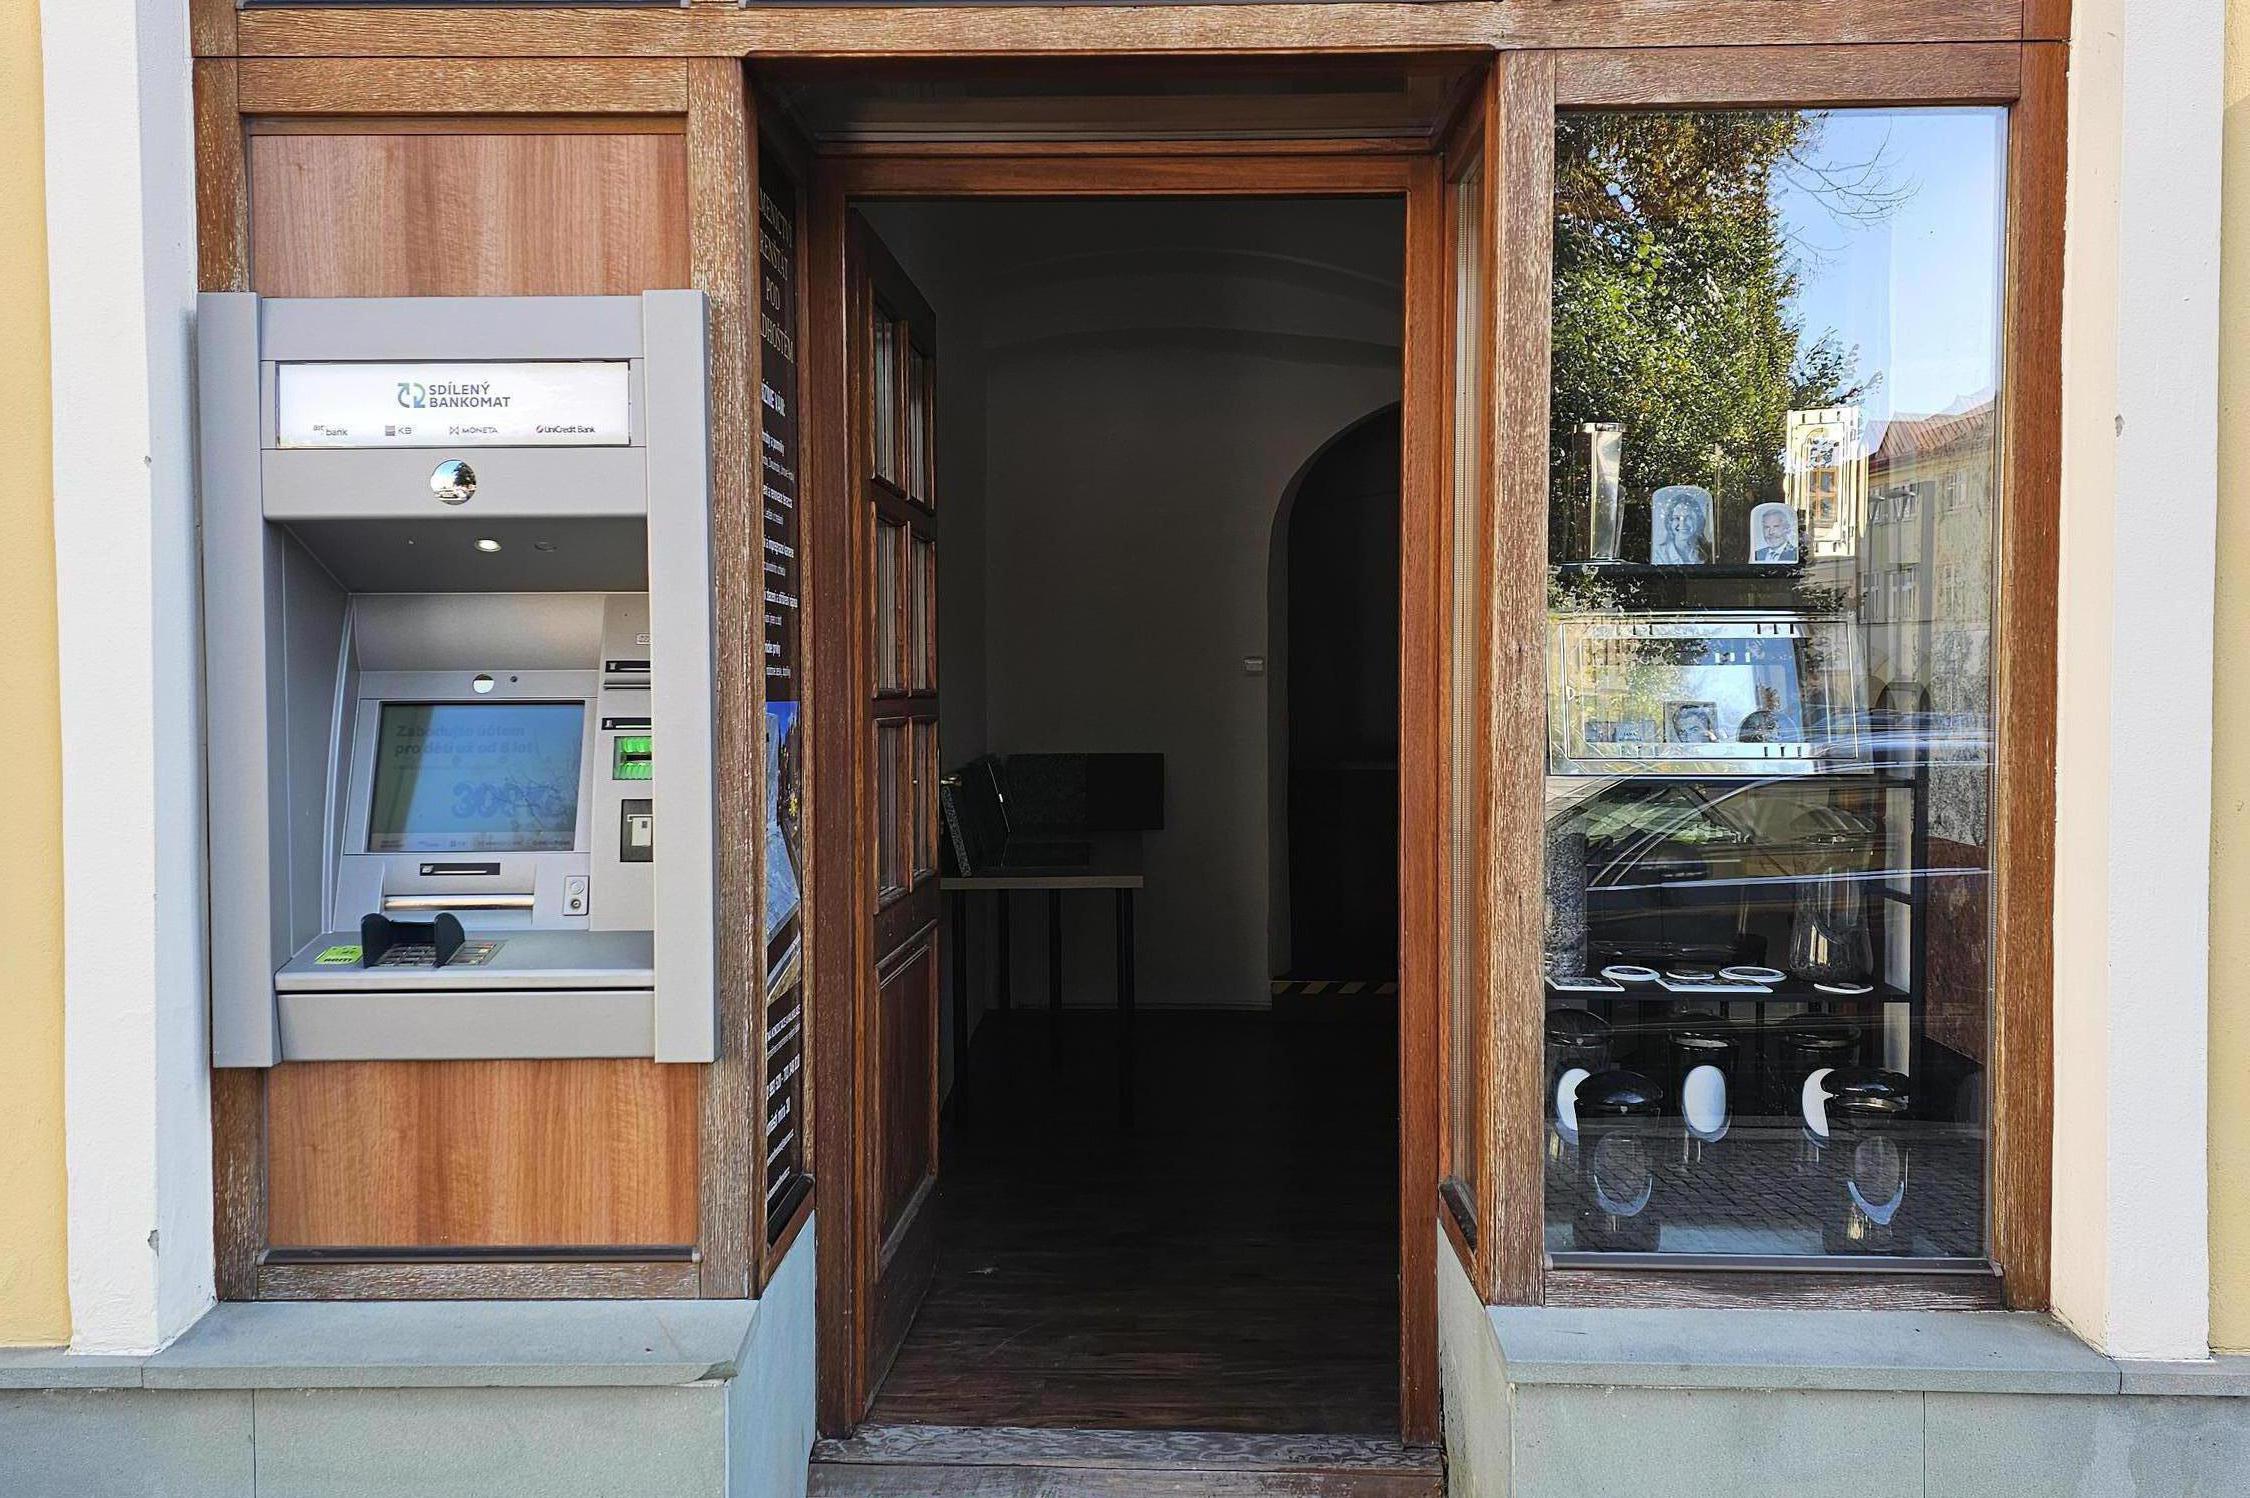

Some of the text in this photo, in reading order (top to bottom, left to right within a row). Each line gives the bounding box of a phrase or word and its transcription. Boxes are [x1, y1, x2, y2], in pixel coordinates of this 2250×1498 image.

[760, 226, 788, 282] RENŠTÁT
[766, 274, 780, 311] POD
[760, 312, 794, 364] DHOŠTĚM
[428, 380, 491, 396] SDÍLENÝ
[428, 396, 511, 409] BANKOMAT
[325, 426, 348, 437] bank
[397, 426, 412, 435] KB
[461, 425, 499, 435] MONETA
[544, 425, 596, 434] UniCredit Bank
[393, 744, 421, 758] pro
[477, 742, 497, 754] od
